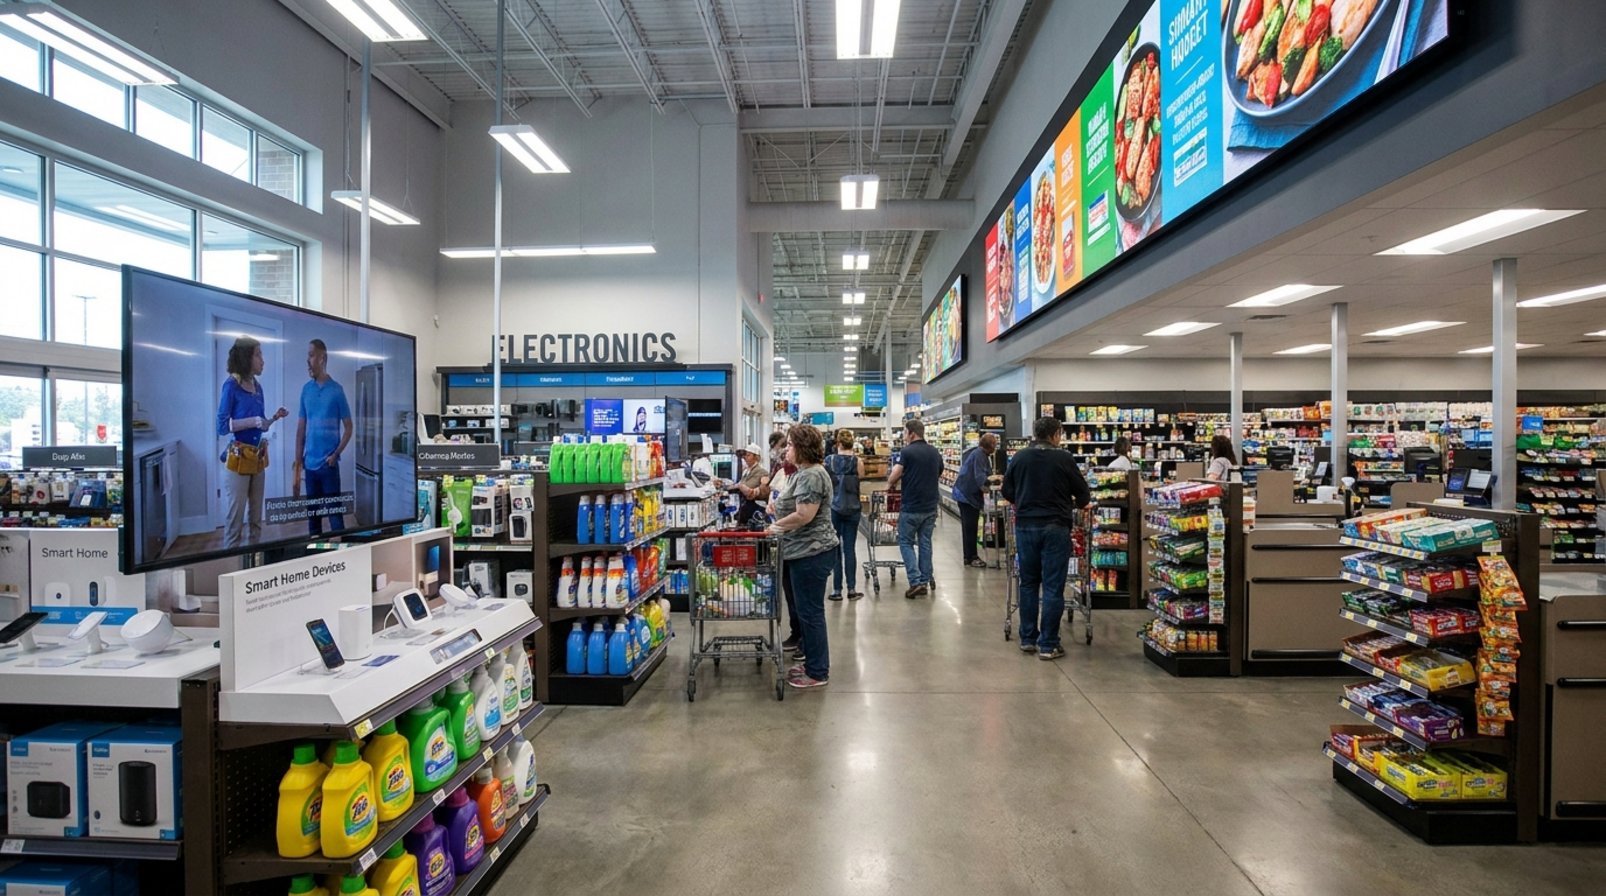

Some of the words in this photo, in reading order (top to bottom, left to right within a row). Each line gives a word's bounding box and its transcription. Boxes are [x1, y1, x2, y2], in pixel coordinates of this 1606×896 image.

[491, 332, 677, 363] ELECTRONICS
[41, 547, 73, 559] Smart
[76, 547, 108, 559] Home
[245, 576, 279, 595] Smart
[312, 561, 347, 578] Devices
